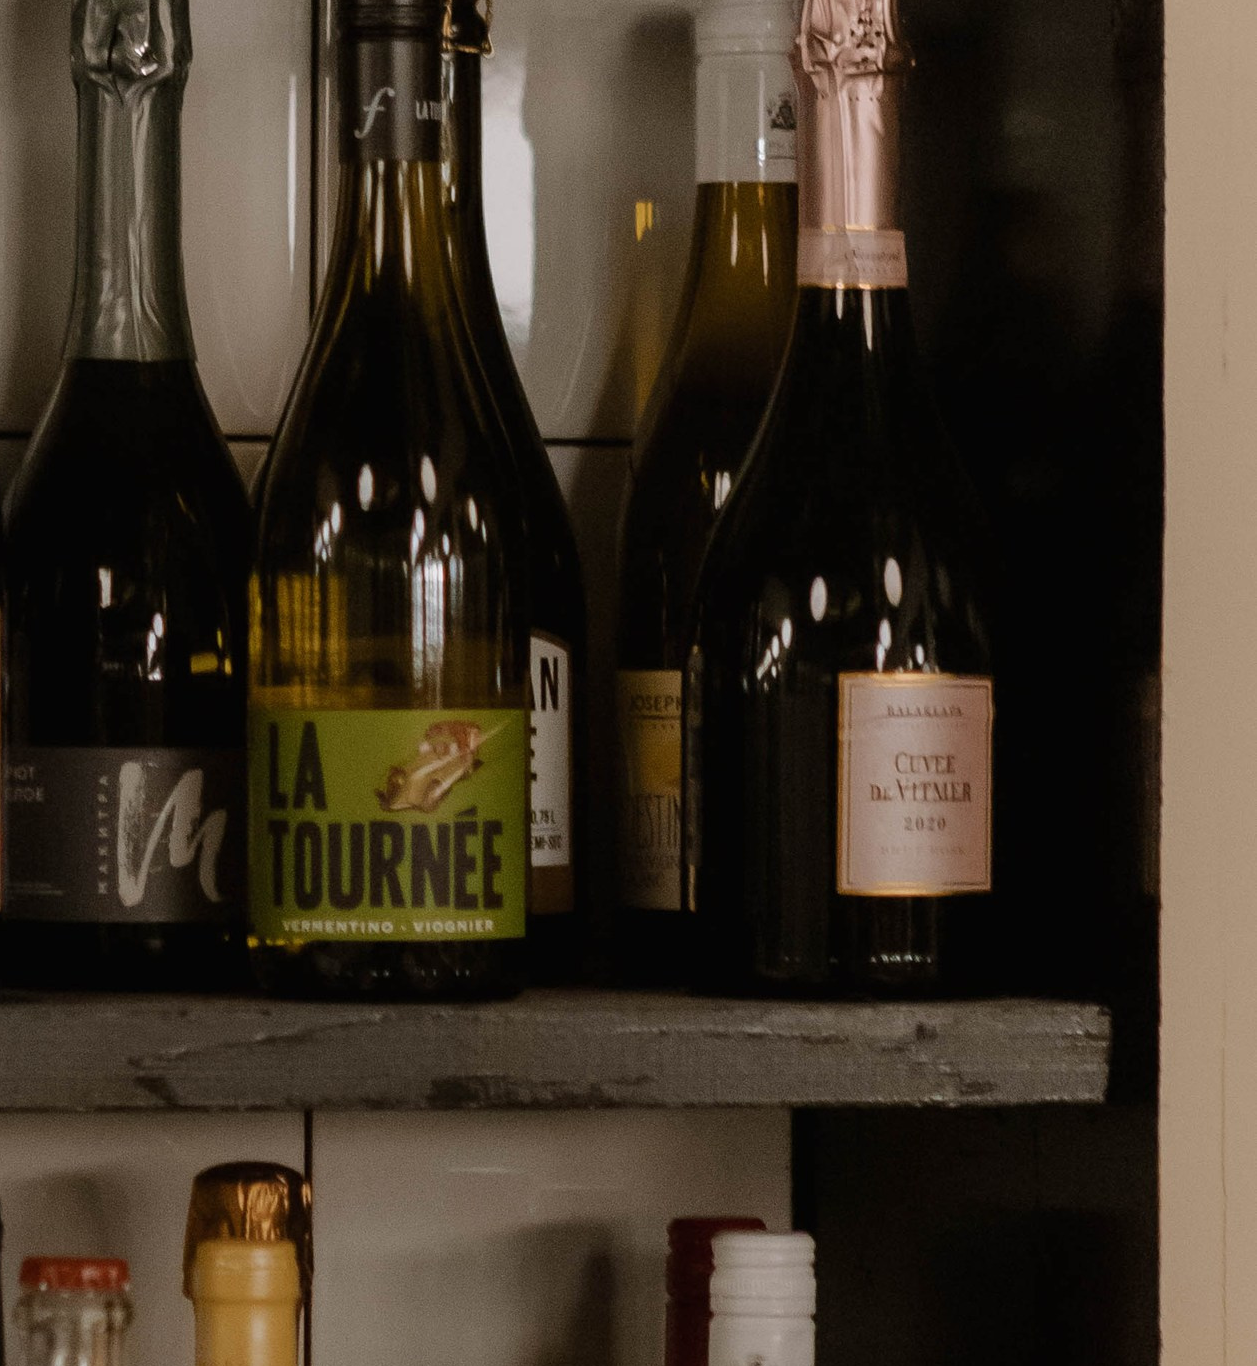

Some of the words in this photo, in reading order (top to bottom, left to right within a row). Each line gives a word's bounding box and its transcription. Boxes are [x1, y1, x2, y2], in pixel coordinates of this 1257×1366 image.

[269, 721, 327, 811] LA
[268, 806, 504, 911] TOURNÉE
[282, 920, 393, 934] VERMENTINO
[413, 920, 494, 933] VIOGNIER
